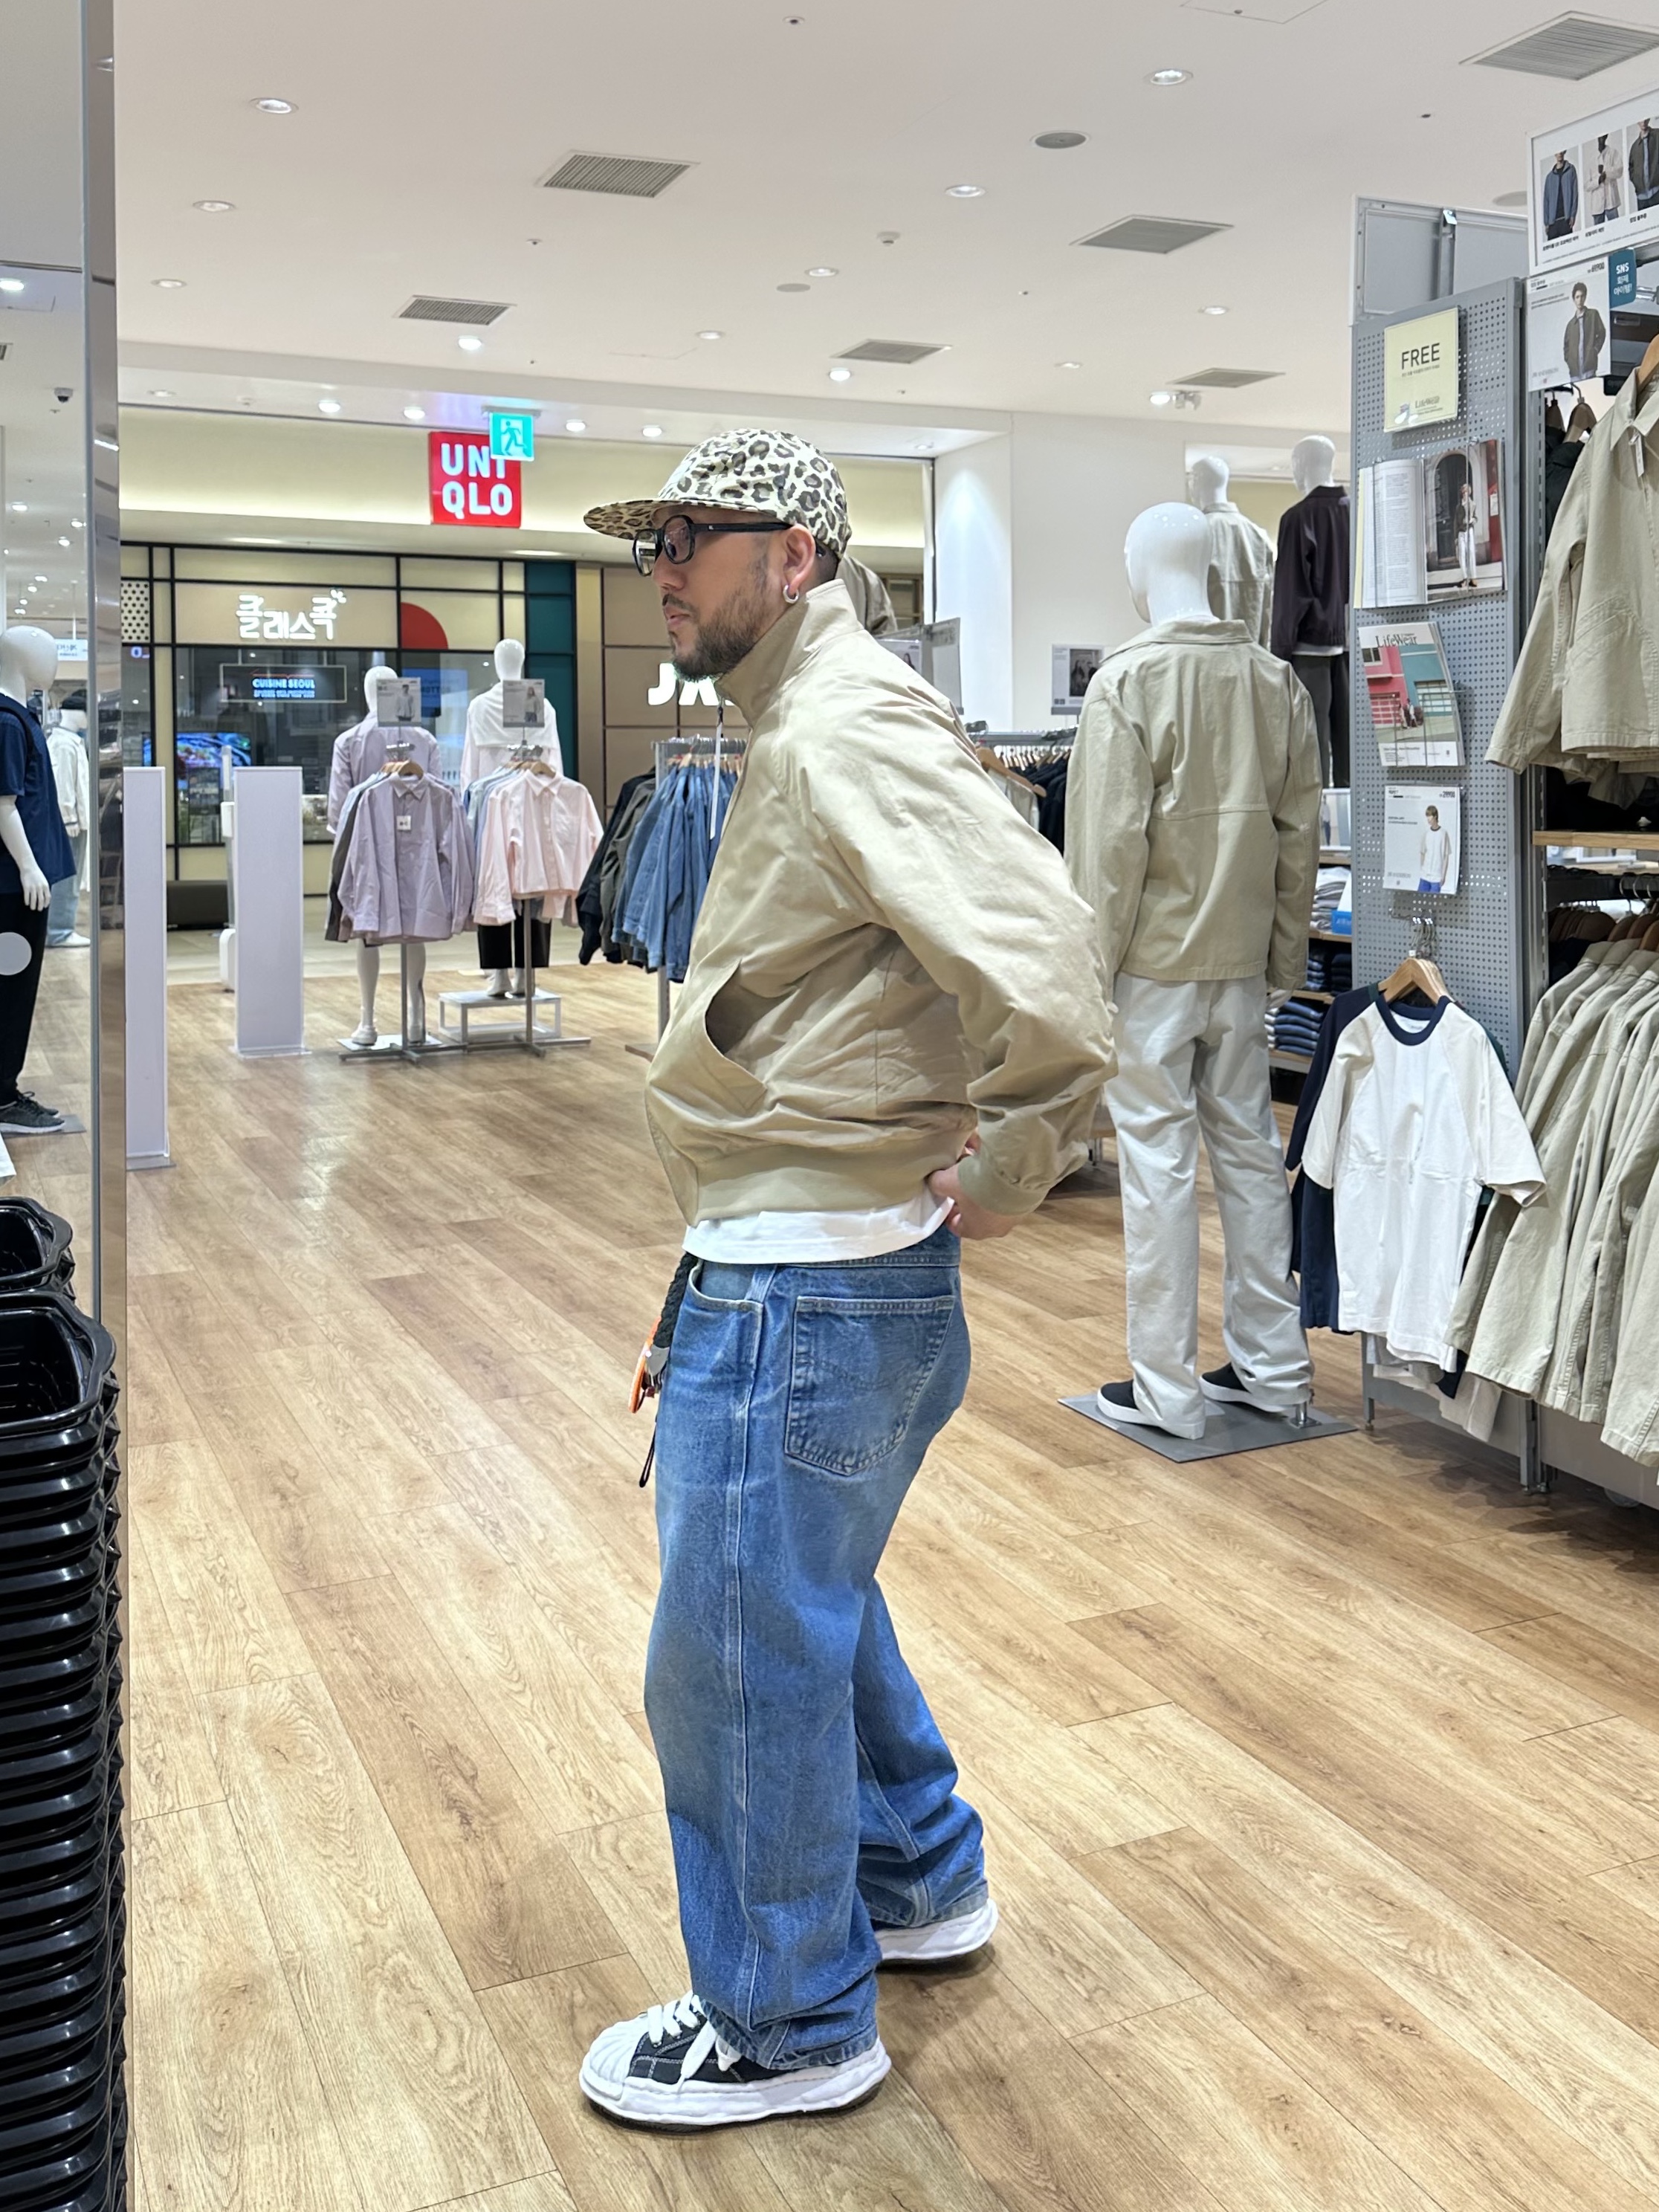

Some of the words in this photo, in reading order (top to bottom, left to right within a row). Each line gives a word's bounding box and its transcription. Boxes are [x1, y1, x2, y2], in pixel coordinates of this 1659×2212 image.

[1616, 262, 1629, 275] SNS
[1401, 343, 1440, 370] FREE
[442, 481, 513, 520] QLO
[1375, 633, 1418, 648] LifeWear
[288, 679, 315, 689] SEOUL
